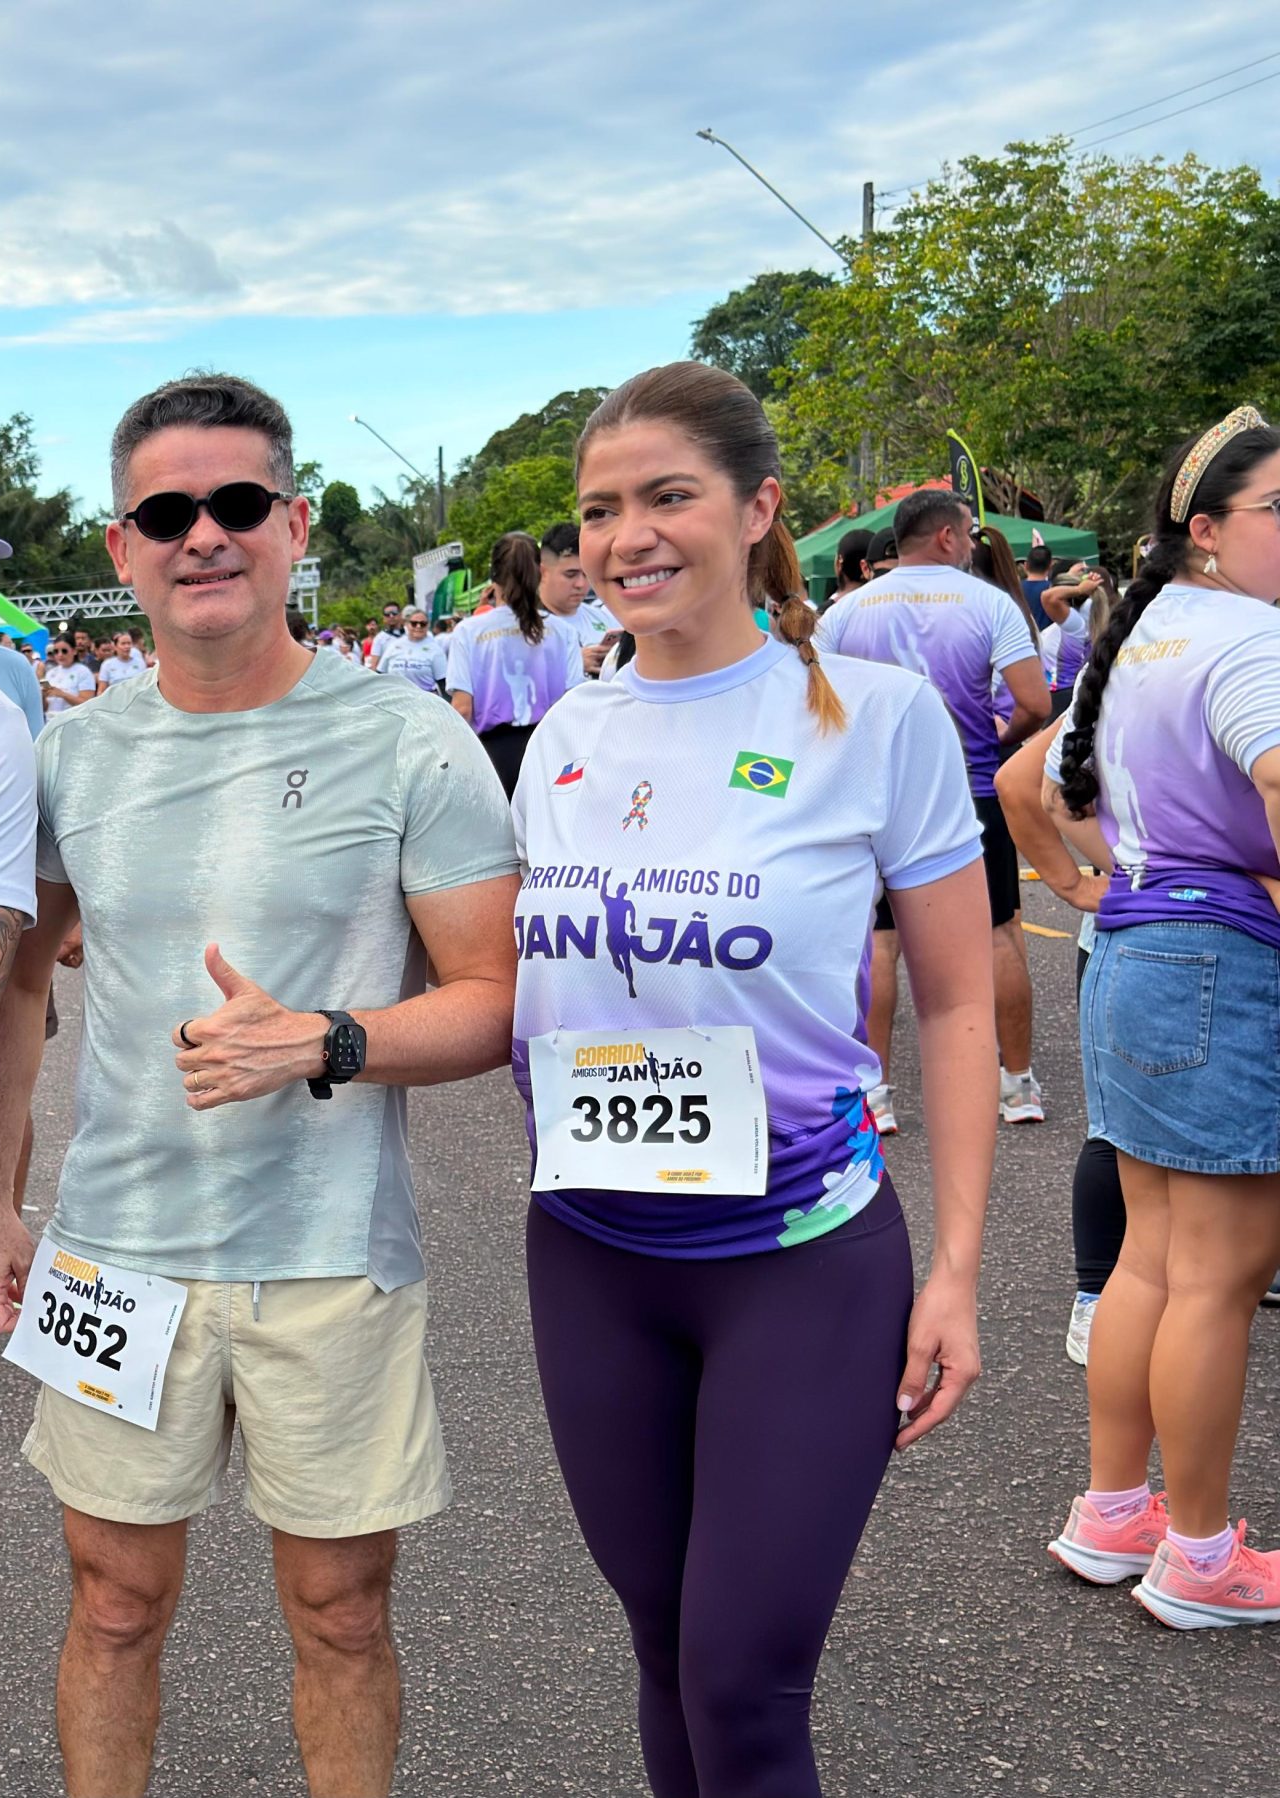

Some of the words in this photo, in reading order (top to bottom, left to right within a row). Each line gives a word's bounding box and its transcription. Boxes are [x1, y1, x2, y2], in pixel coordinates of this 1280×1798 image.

[631, 868, 720, 896] AMIGOS
[727, 872, 760, 900] DO
[629, 911, 774, 971] JÃO
[571, 1067, 598, 1078] AMIGOS
[598, 1067, 608, 1077] DO
[606, 1064, 648, 1083] JAN
[659, 1057, 702, 1080] JÃO
[575, 1042, 645, 1067] CORRIDA
[570, 1094, 711, 1144] 3825
[53, 1249, 99, 1284] CORRIDA
[65, 1276, 95, 1300] JAN
[100, 1290, 136, 1313] JÃO
[38, 1291, 128, 1372] 3852
[1226, 1584, 1264, 1602] FILA
